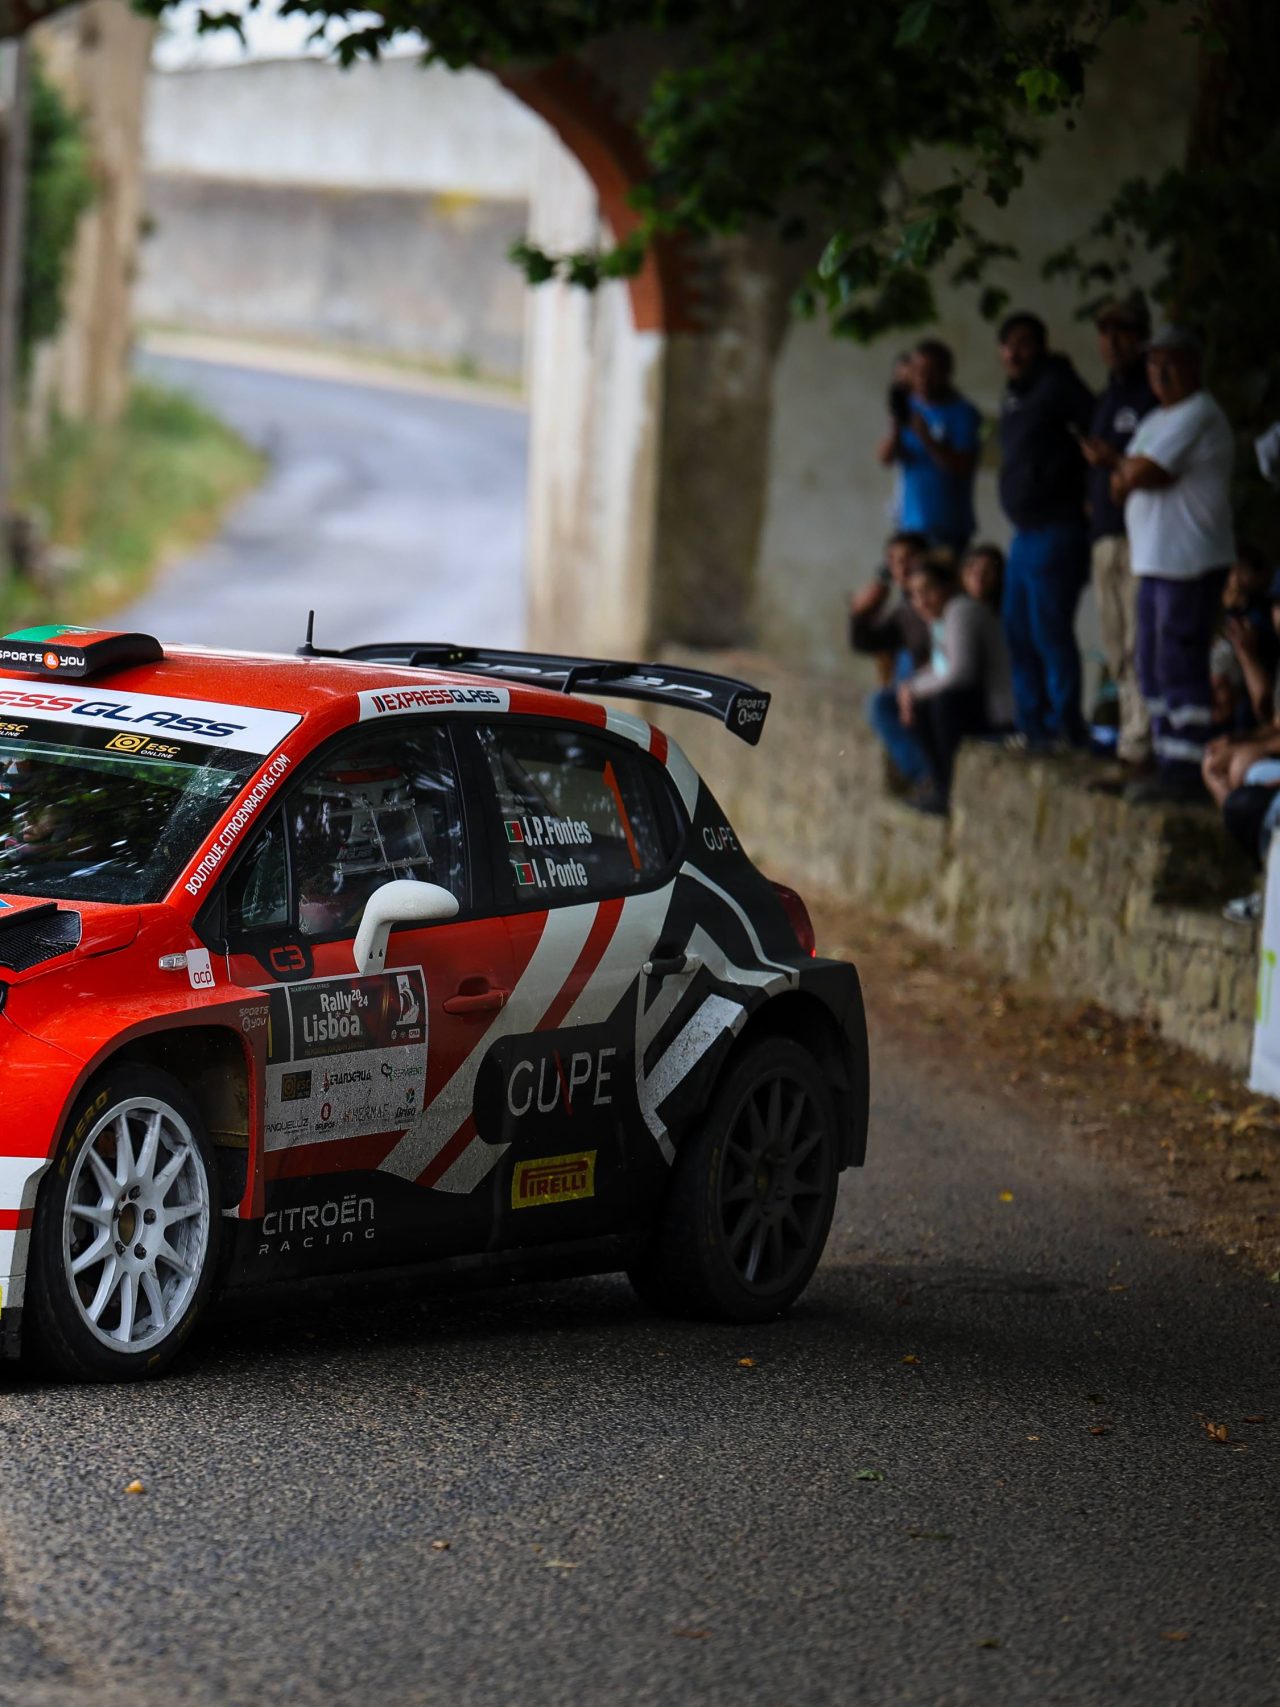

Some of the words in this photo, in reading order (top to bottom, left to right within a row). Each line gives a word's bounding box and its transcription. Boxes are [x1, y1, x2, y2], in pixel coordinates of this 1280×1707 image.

[59, 655, 85, 667] YOU
[737, 698, 767, 710] SPORTS
[140, 750, 174, 759] ONLINE
[145, 742, 181, 755] ESC
[185, 753, 291, 895] BOUTIQUE.CITROENRACING.COM
[545, 858, 588, 888] Ponte
[269, 944, 306, 972] C3
[193, 970, 212, 984] acp
[320, 991, 353, 1013] Rally
[303, 1012, 361, 1043] Lisboa
[507, 1047, 617, 1117] GUPE
[520, 1160, 589, 1198] PIRELLI
